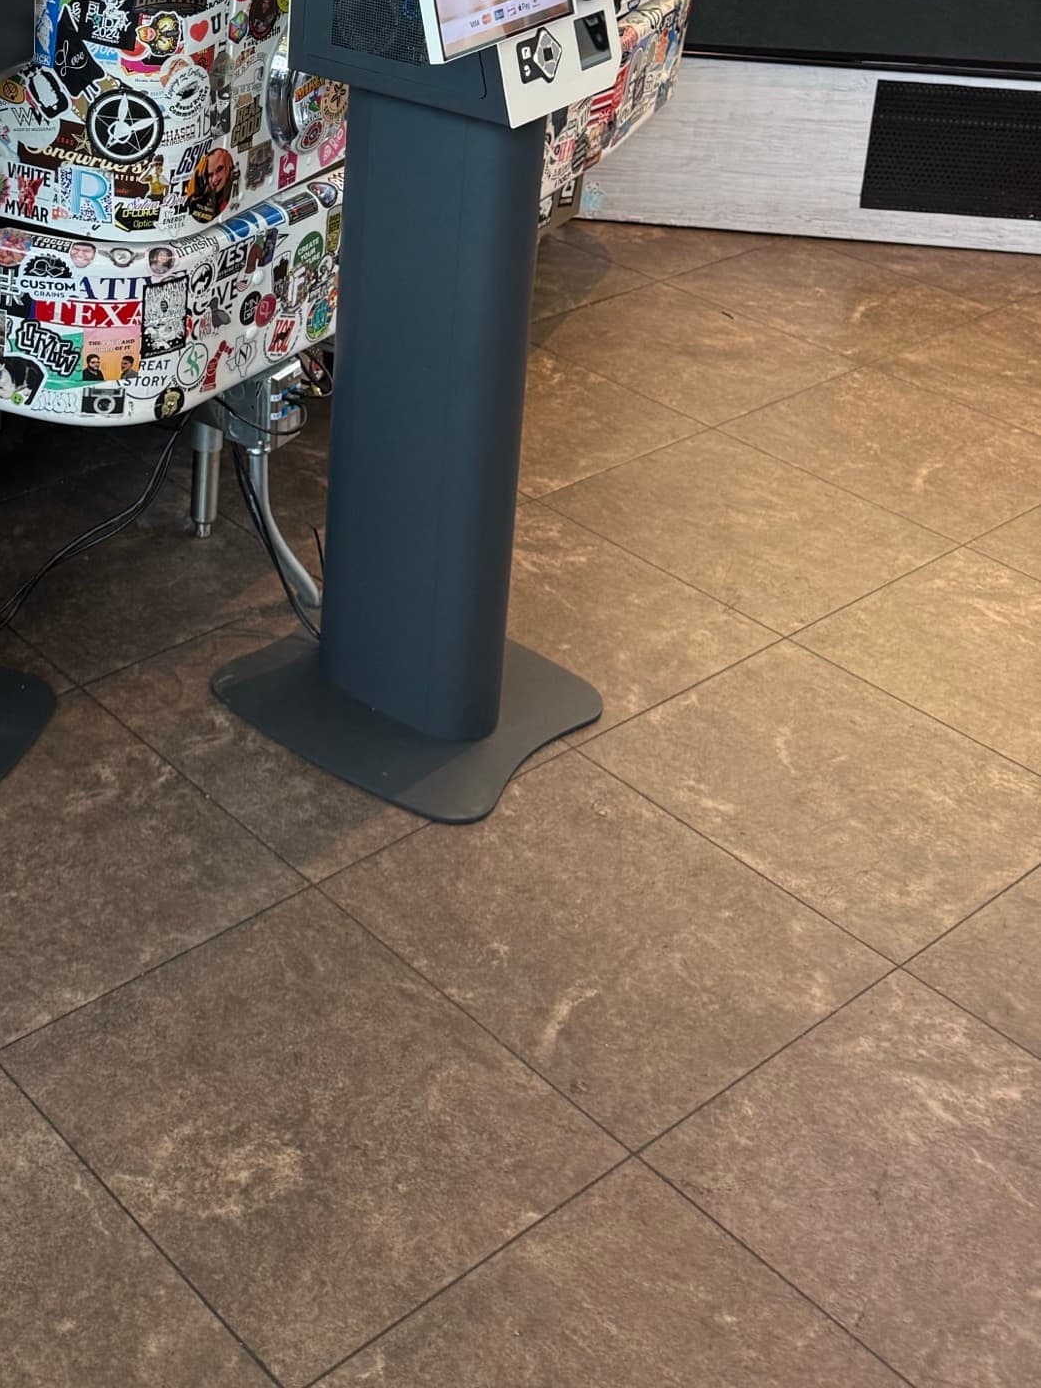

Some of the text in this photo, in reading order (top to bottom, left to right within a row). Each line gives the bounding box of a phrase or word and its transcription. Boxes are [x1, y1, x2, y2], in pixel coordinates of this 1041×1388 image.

[92, 25, 121, 40] 2024
[8, 162, 51, 188] WHITE
[5, 199, 49, 223] MYLAR
[20, 280, 76, 292] CUSTOM
[34, 290, 65, 299] GRAINS
[49, 300, 143, 327] TEXA
[124, 376, 167, 387] STORY
